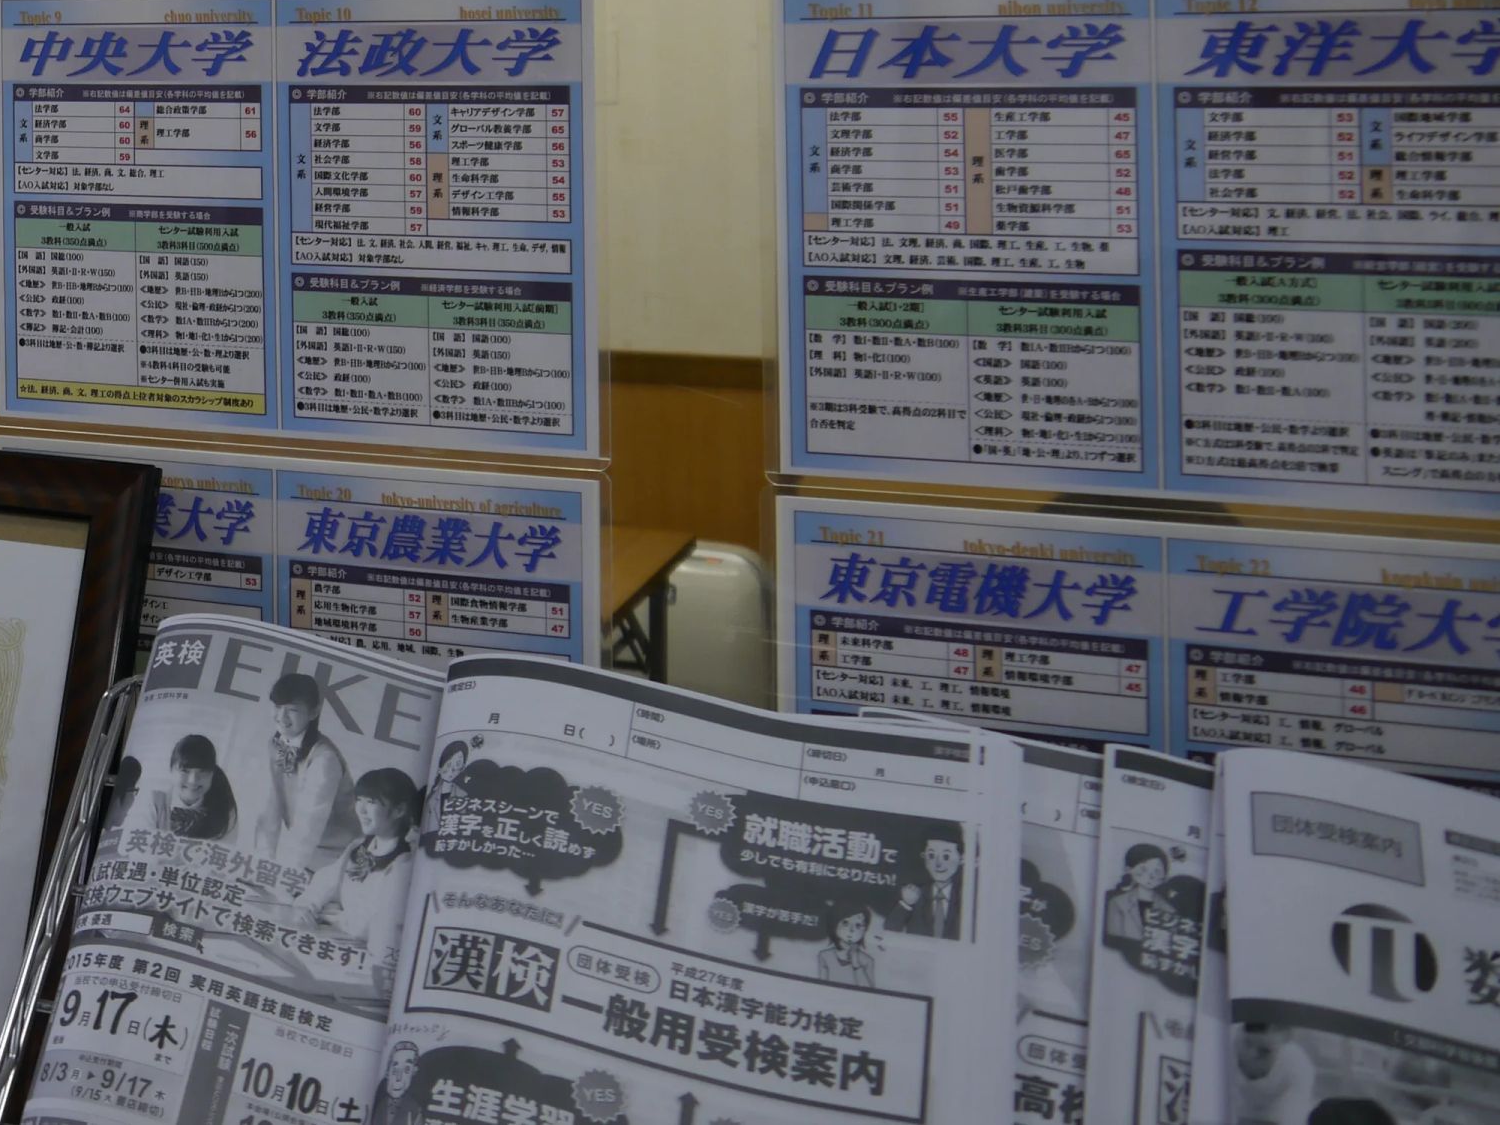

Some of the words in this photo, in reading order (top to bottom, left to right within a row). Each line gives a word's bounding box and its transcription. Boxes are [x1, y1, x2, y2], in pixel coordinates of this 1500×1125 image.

[19, 30, 254, 77] 中央大学
[296, 27, 560, 77] 法政大学
[808, 23, 1126, 79] 日本大学
[410, 173, 422, 182] 60
[552, 176, 564, 185] 54
[297, 507, 561, 573] 東京農業大学
[409, 593, 421, 603] 52
[551, 606, 564, 616] 51
[820, 553, 1138, 626] 東京電機大学
[409, 611, 421, 620] 57
[551, 624, 564, 633] 47
[409, 628, 421, 637] 50
[1198, 586, 1500, 655] 工学院大
[152, 640, 206, 668] 英検
[443, 798, 560, 824] ビジネスシーンで
[582, 798, 613, 819] YES
[698, 803, 725, 820] YES
[438, 814, 596, 859] 漢字を正しく読めず
[743, 813, 898, 865] 就職活動で
[1271, 813, 1404, 860] 団体受検案内
[162, 922, 195, 943] 検索
[431, 930, 559, 1011] 漢検
[577, 951, 652, 988] 団体受検
[132, 958, 181, 983] 第2回
[189, 974, 333, 1033] 実用英語技能検定
[669, 980, 863, 1041] 日本漢字能力検定
[562, 991, 887, 1097] 一般用受検案内
[583, 1084, 616, 1104] YES
